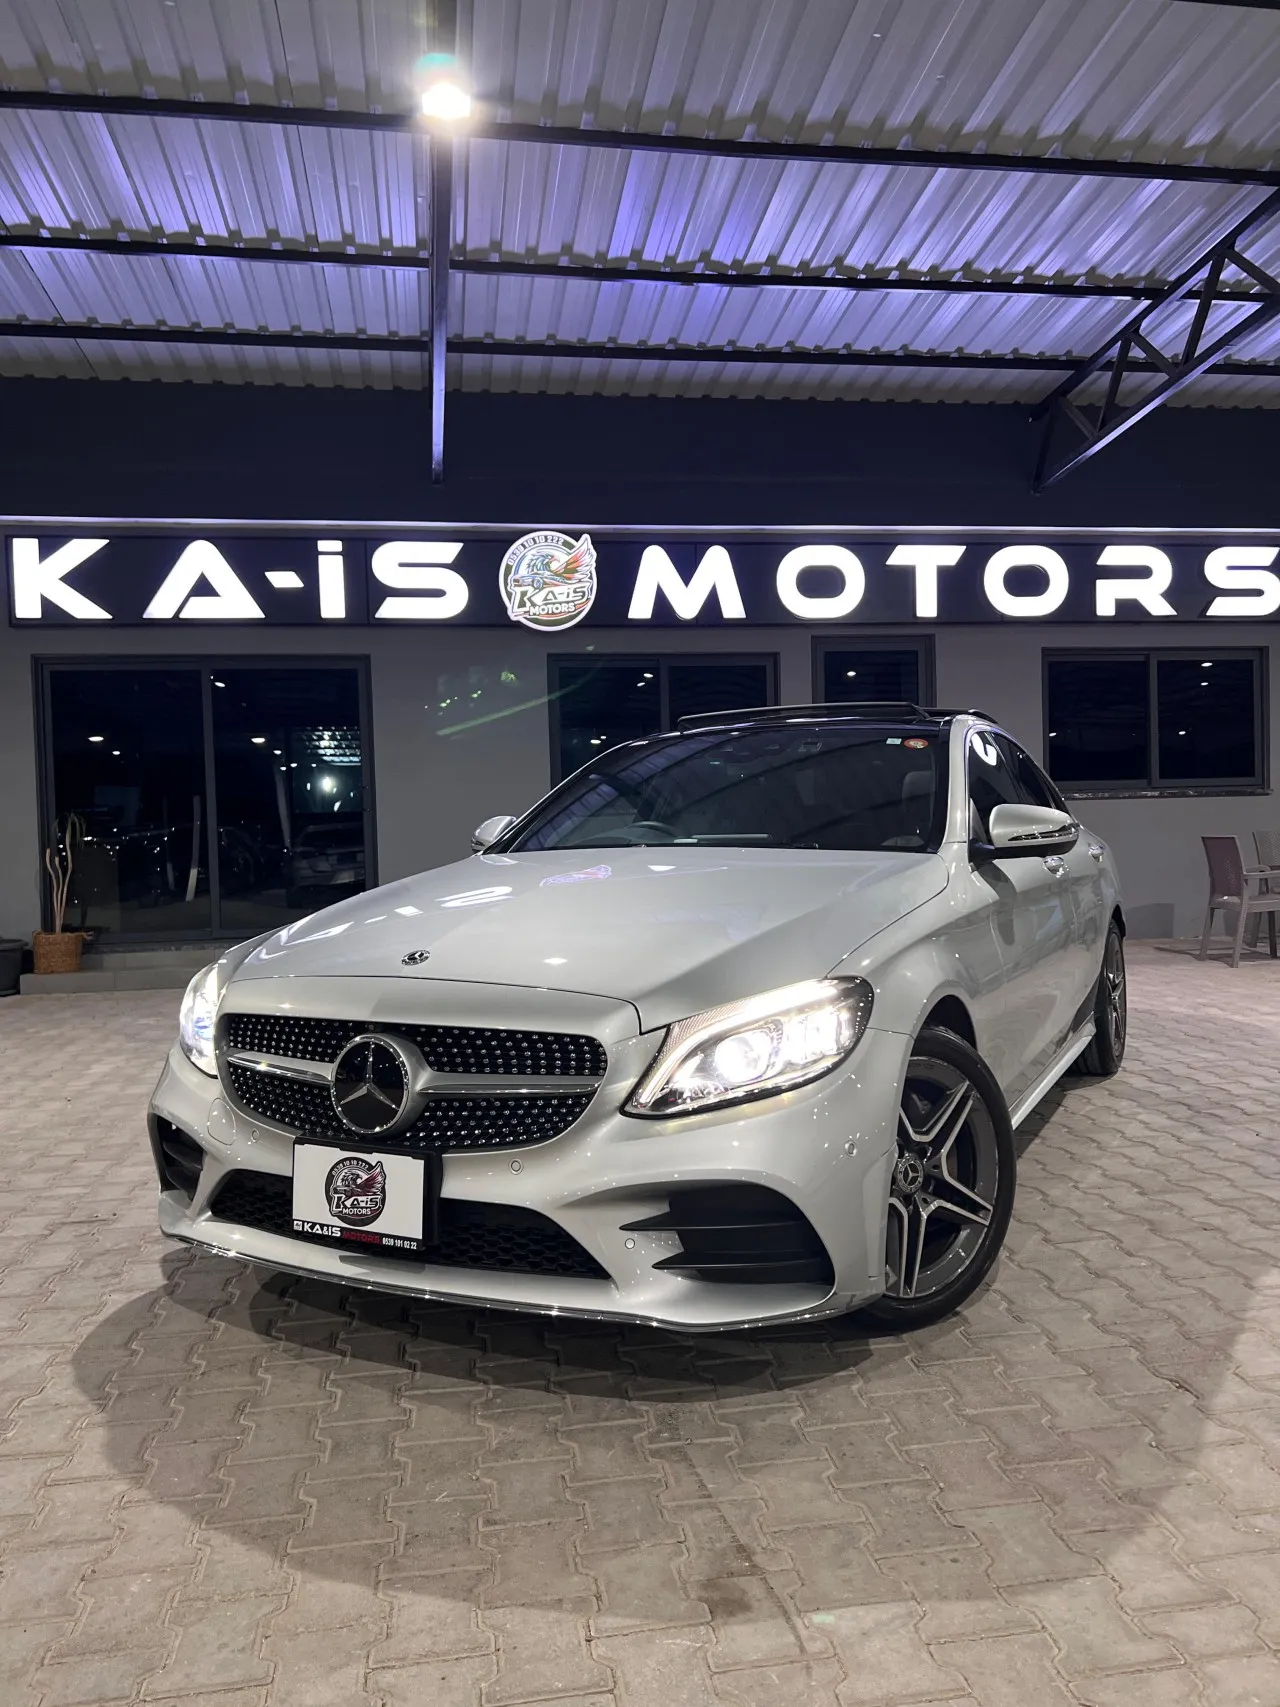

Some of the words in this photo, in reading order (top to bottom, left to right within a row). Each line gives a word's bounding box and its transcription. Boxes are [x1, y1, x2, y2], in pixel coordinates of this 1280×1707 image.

[523, 537, 535, 549] 10
[534, 535, 546, 544] 10
[547, 535, 564, 546] 222
[12, 537, 469, 620] KA-iS
[627, 544, 1280, 619] MOTORS
[512, 585, 587, 613] KA-iS
[529, 603, 576, 616] MOTORS
[332, 1194, 380, 1211] KA-iS
[303, 1221, 341, 1237] KA&iS
[343, 1231, 380, 1244] MOTORS
[403, 1240, 411, 1249] 02
[410, 1241, 417, 1250] 22
